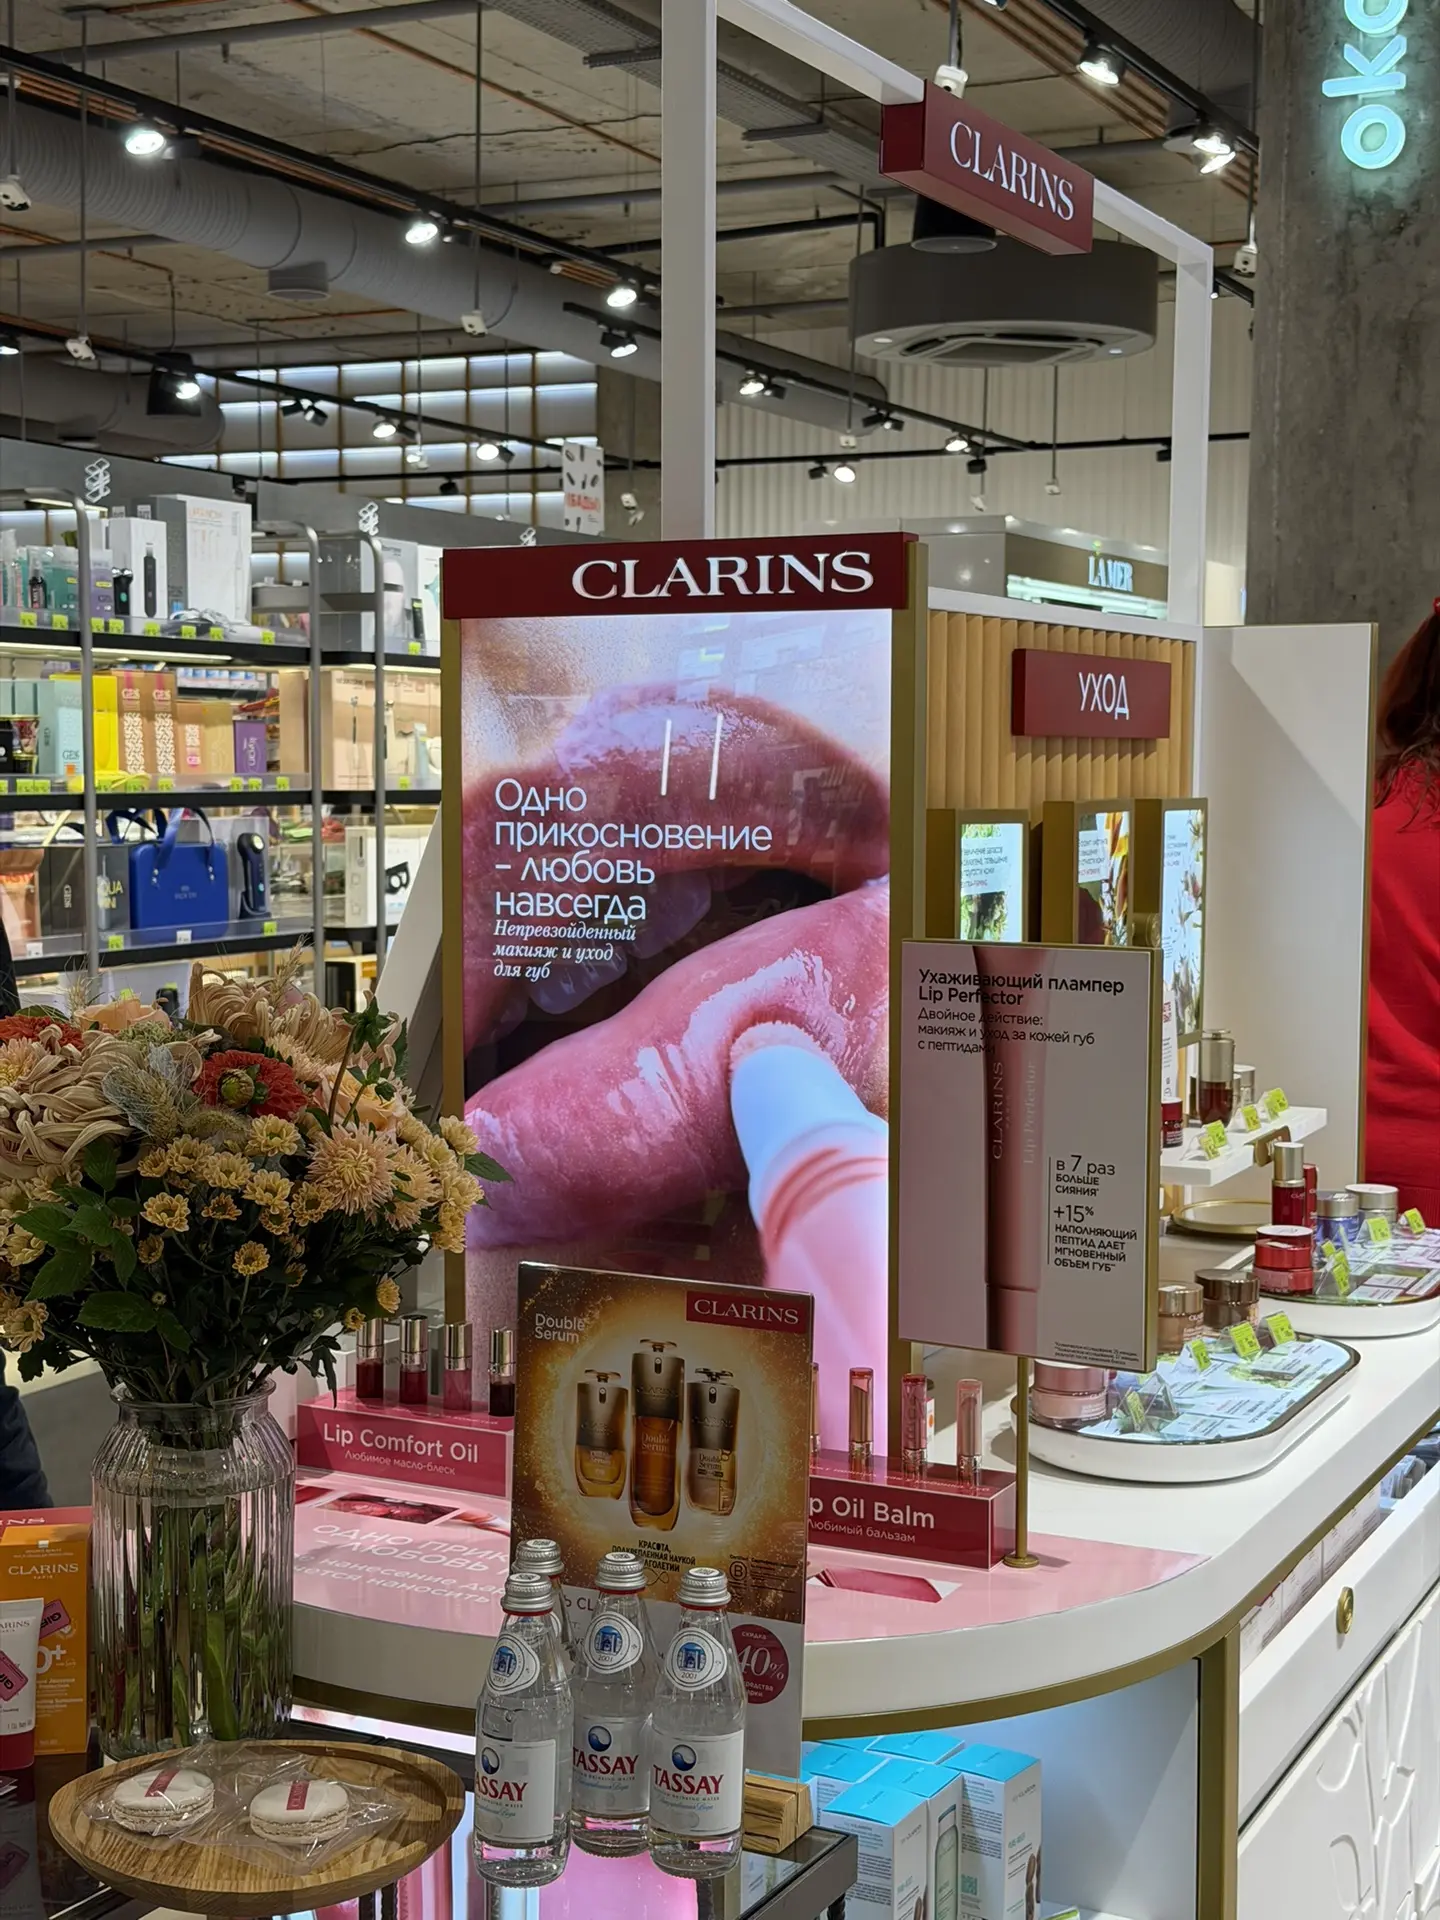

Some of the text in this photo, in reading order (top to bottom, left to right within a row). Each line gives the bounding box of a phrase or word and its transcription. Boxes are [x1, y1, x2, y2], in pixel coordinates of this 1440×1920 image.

[949, 120, 1075, 221] CLARINS
[571, 551, 875, 600] CLARINS
[1078, 671, 1130, 721] УХОД
[494, 777, 588, 815] Одно
[494, 819, 773, 853] прикосновение
[520, 851, 656, 885] любовь
[495, 891, 647, 925] навсегда
[493, 919, 637, 941] Непревзойденный
[492, 943, 614, 964] макияж и уход
[493, 959, 553, 982] для губ
[919, 968, 1125, 996] Ухаживающий плампер
[919, 986, 1024, 1006] Lip Perfector
[917, 1006, 1044, 1027] Двойное действие:
[917, 1024, 1096, 1047] макияж и уход за кожей губ
[917, 1039, 925, 1050] с
[993, 1062, 1004, 1160] CLARINS
[1056, 1154, 1116, 1176] в 7 раз
[1056, 1173, 1100, 1186] БОЛЬШЕ
[1053, 1204, 1095, 1223] +15%
[1055, 1223, 1138, 1241] НАПОЛНЯЮЩИЙ
[1055, 1235, 1126, 1251] ПЕПТИД ДАЕТ
[1054, 1257, 1090, 1270] ОБЪЕМ
[1055, 1246, 1127, 1263] МГНОВЕННЫЙ
[535, 1312, 586, 1332] Double
[694, 1298, 800, 1325] CLARINS
[535, 1327, 580, 1344] Serum
[323, 1422, 479, 1464] Lip Comfort Oil
[344, 1450, 456, 1476] Любимое масло-блеск
[832, 1496, 865, 1519] Oil
[873, 1501, 935, 1530] Balm
[312, 1523, 414, 1546] ОДНО
[638, 1539, 673, 1553] КРАСОТА,
[866, 1526, 916, 1544] бальзам
[335, 1542, 490, 1572] ЛЮБОВЬ
[669, 1555, 697, 1567] НАУКОЙ
[8, 1562, 80, 1576] CLARINS
[572, 1746, 640, 1775] TASSAY
[652, 1763, 725, 1795] TASSAY
